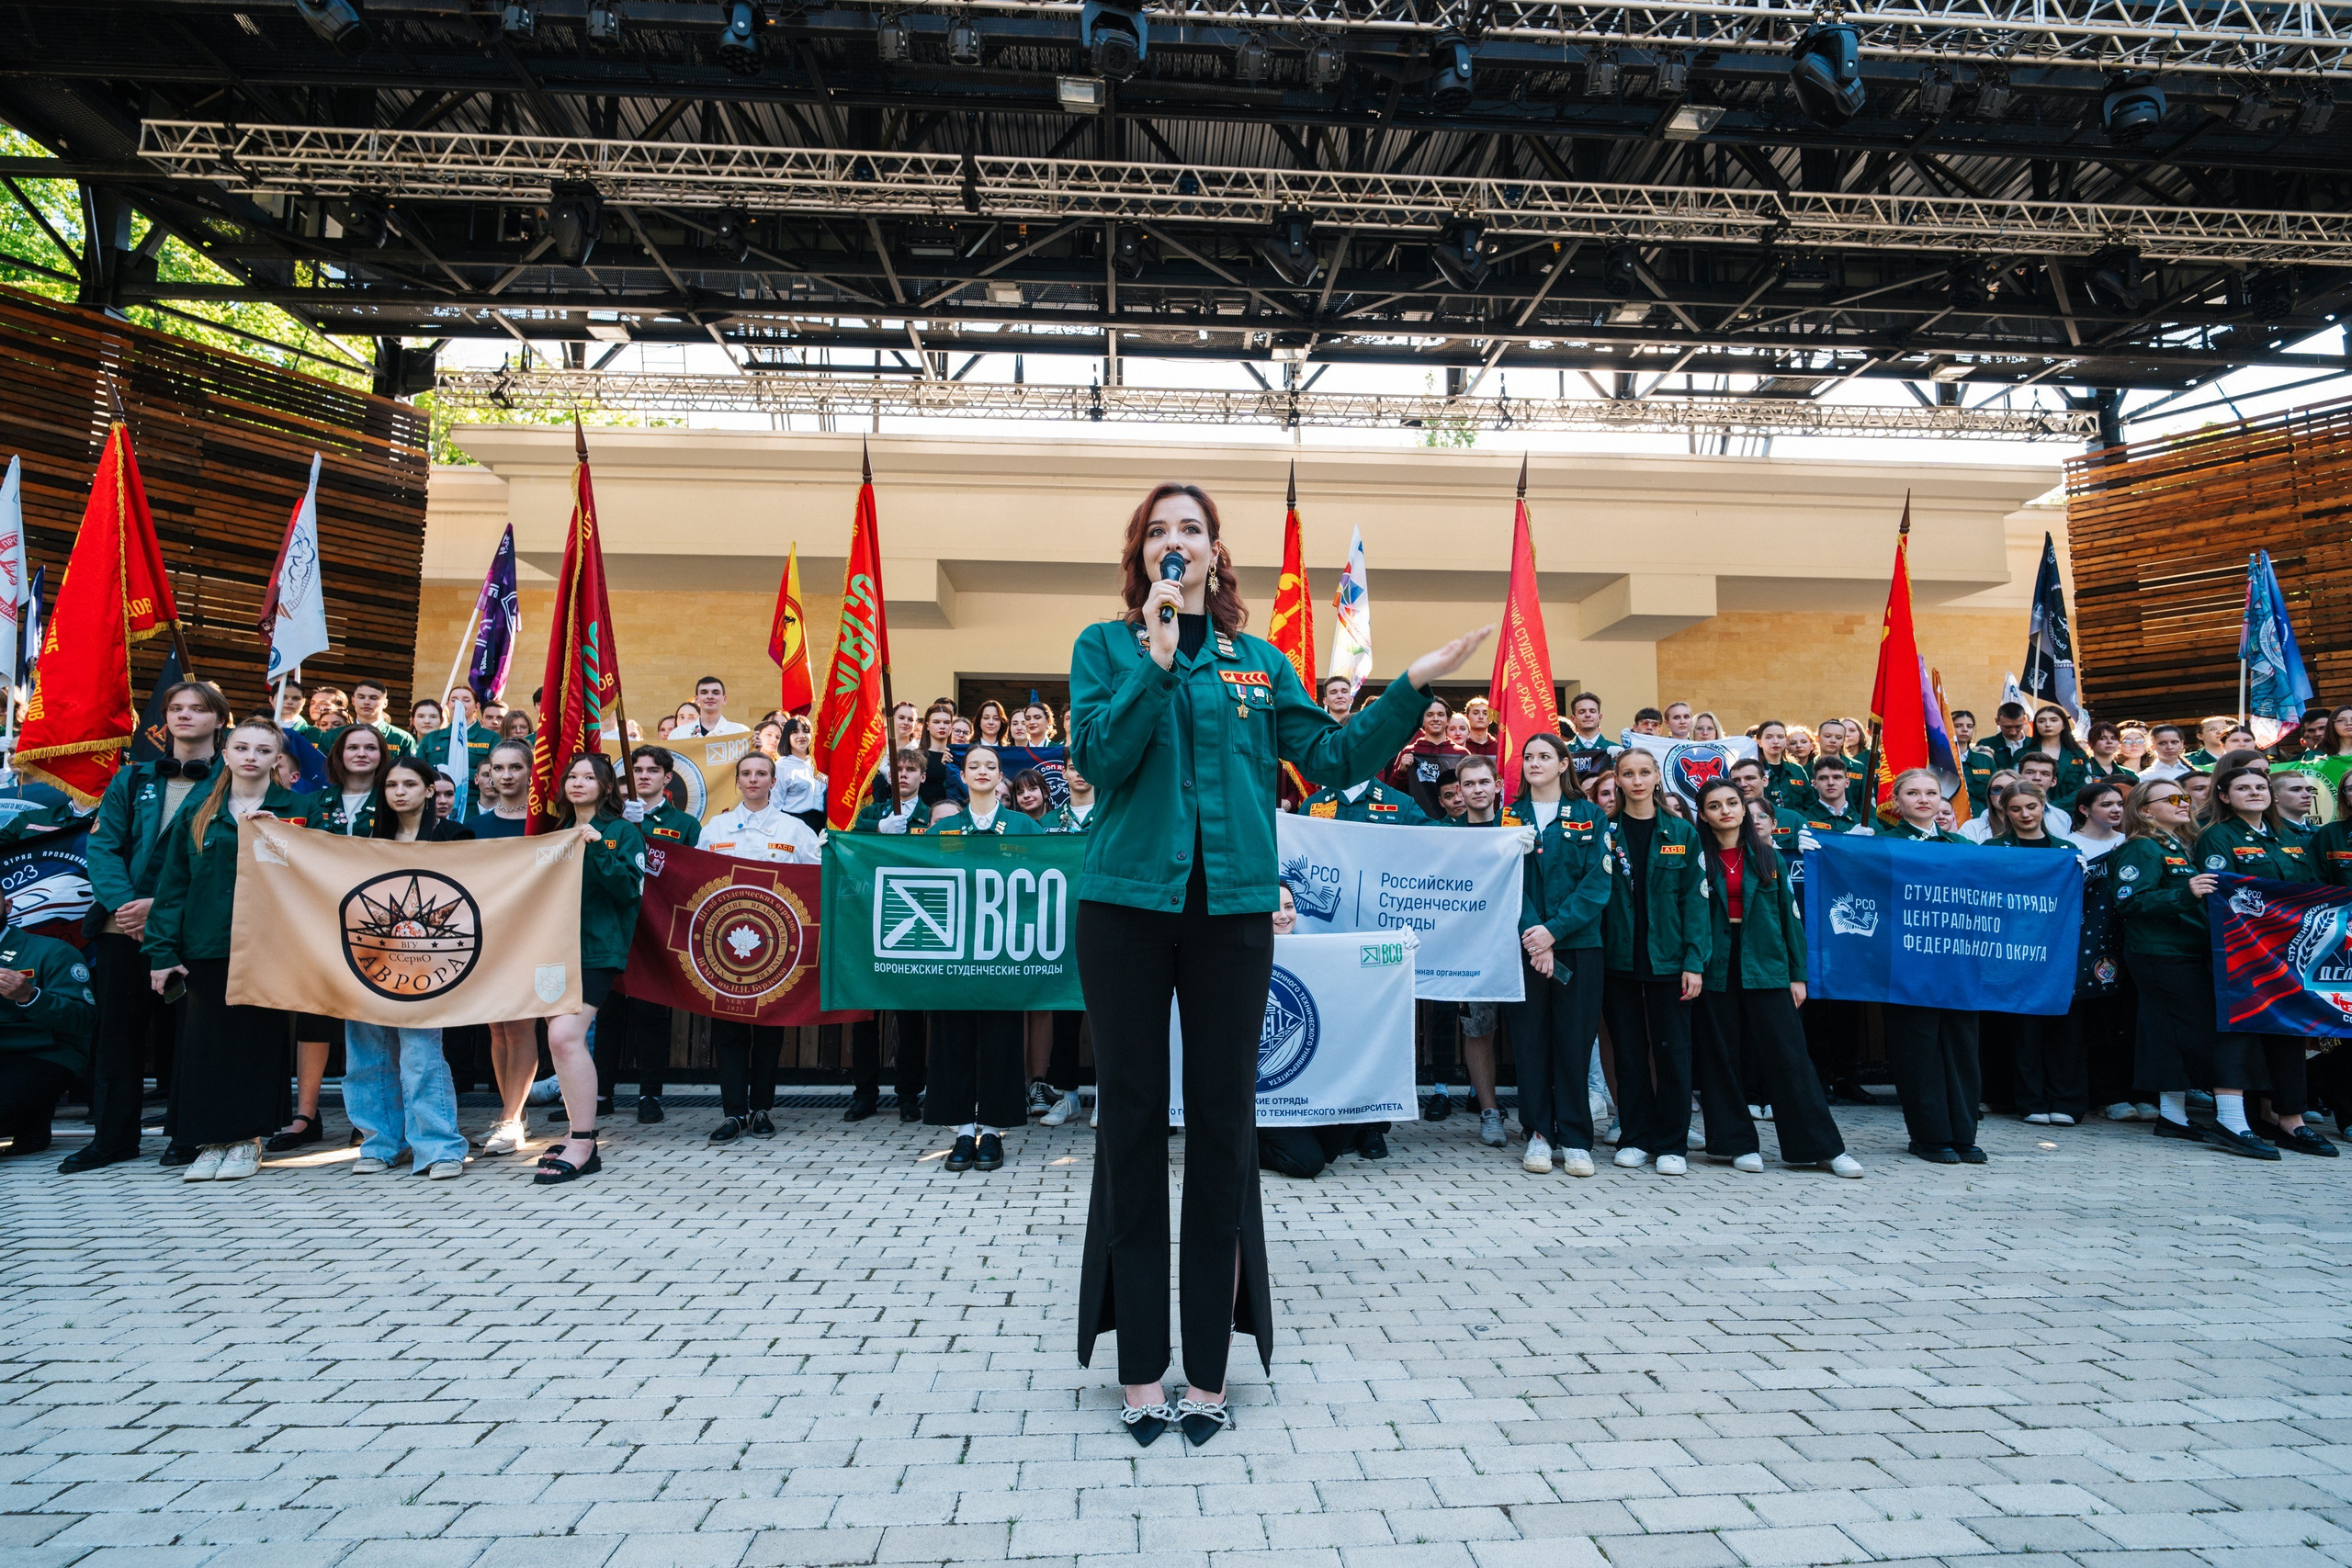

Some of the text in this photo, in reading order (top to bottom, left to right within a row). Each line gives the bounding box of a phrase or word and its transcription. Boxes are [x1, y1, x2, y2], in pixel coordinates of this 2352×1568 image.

[127, 597, 153, 617] ДОВ
[1514, 626, 1556, 712] СТУДЕНЧЕСКИЙ
[1516, 682, 1535, 719] «РЖД»
[728, 738, 749, 761] ВСО
[533, 736, 553, 794] ШТА
[4, 852, 33, 866] ОТРЯД
[649, 848, 666, 859] РСО
[1, 864, 39, 890] 023
[1310, 864, 1340, 884] РСО
[1381, 873, 1474, 892] Российские
[1379, 892, 1487, 912] Студенческие
[1855, 898, 1876, 910] РСО
[1905, 884, 2058, 914] СТУДЕНЧЕСКИЕ ОТРЯДЫ
[2247, 889, 2262, 899] РСО
[697, 890, 797, 933] Штаб студенческих отрядов
[973, 868, 1068, 962] ВСО
[1377, 912, 1436, 931] Отряды
[1903, 909, 2001, 933] ЦЕНТРАЛЬНОГО
[1382, 943, 1403, 964] ВСО
[1903, 933, 2047, 962] ФЕДЕРАЛЬНОГО ОКРУГА
[389, 953, 432, 965] ССервО
[874, 962, 1063, 976] ВОРОНЕЖСКИЕ СТУДЕНЧЕСКИЕ ОТРЯДЫ
[358, 955, 467, 991] АВРОРА
[697, 956, 717, 980] ВГМУ
[752, 967, 788, 993] Бурденко
[1436, 969, 1481, 977] организация
[1268, 968, 1315, 1087] ВЕННОГО ТЕХНИЧЕСКОГО УНИВЕРСИТЕТА
[1256, 1102, 1403, 1117] ГО ТЕХНИЧЕСКОГО УНИВЕРСИТЕТА
[1272, 1097, 1308, 1105] ОТРЯДЫ
